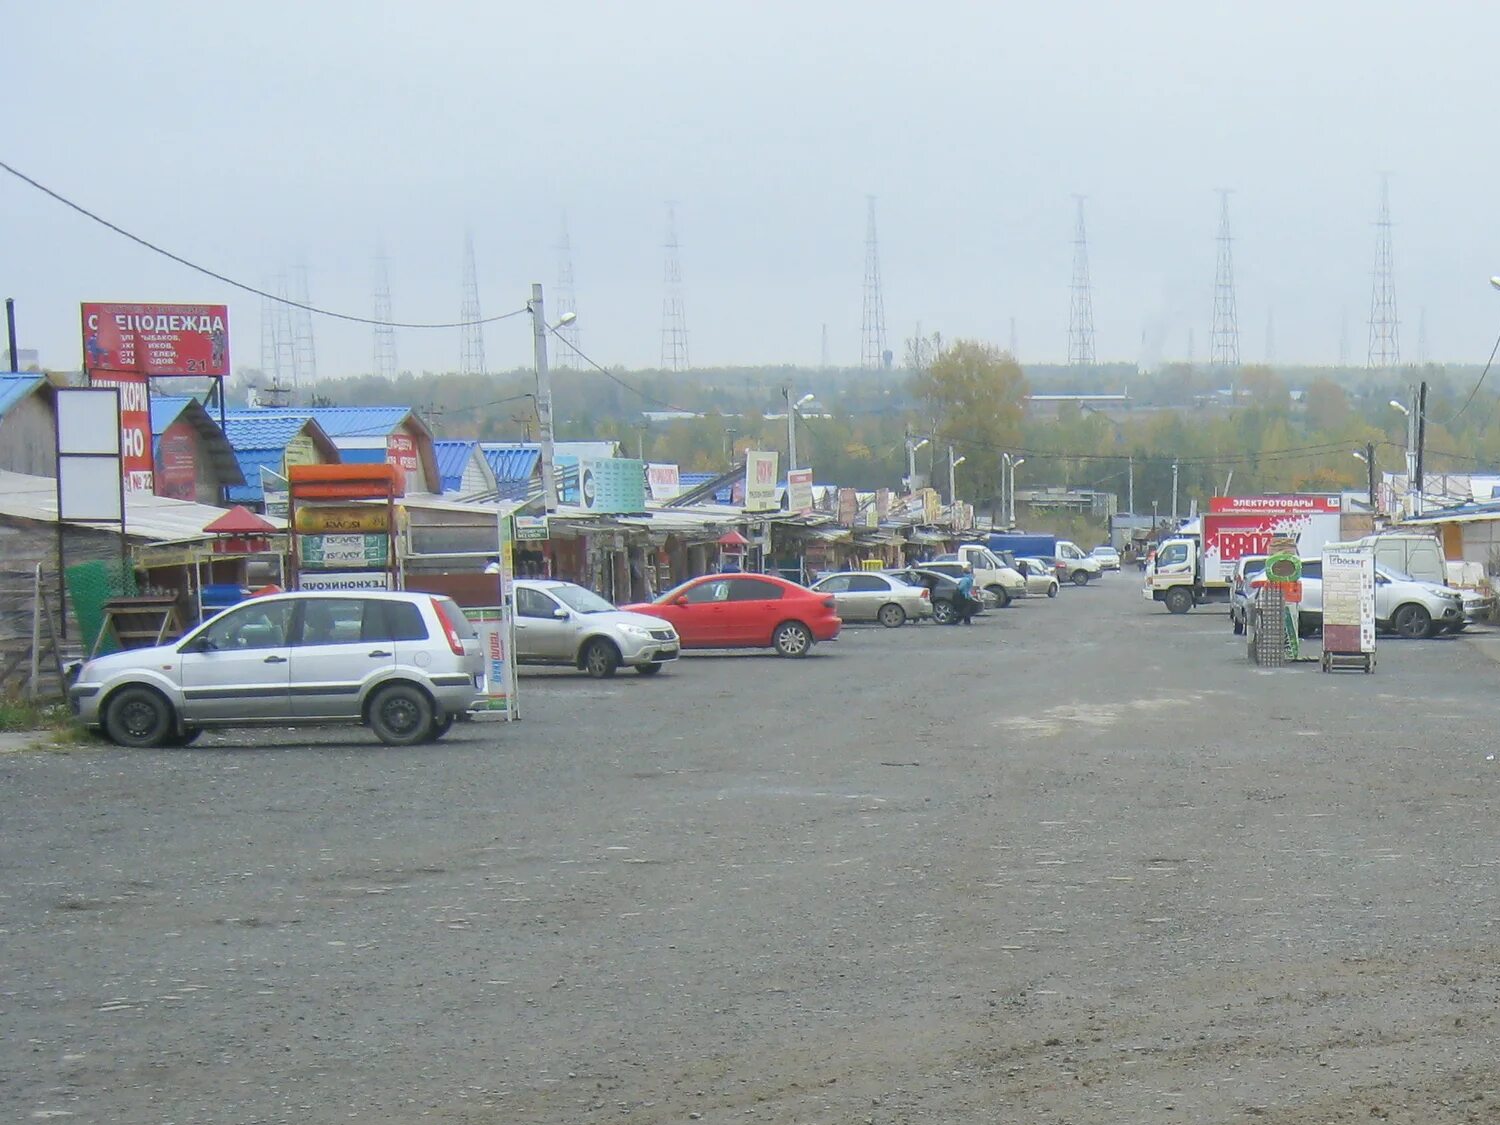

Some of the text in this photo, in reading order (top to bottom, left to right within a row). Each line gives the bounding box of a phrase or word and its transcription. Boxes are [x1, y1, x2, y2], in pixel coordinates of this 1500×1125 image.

[88, 314, 225, 333] СЕЦОДЕЖДА
[186, 359, 207, 372] 21
[1233, 499, 1313, 508] ЭЛЕКТРОТОВАРЫ
[302, 580, 388, 591] ТЕХНОНИКОЛЬ
